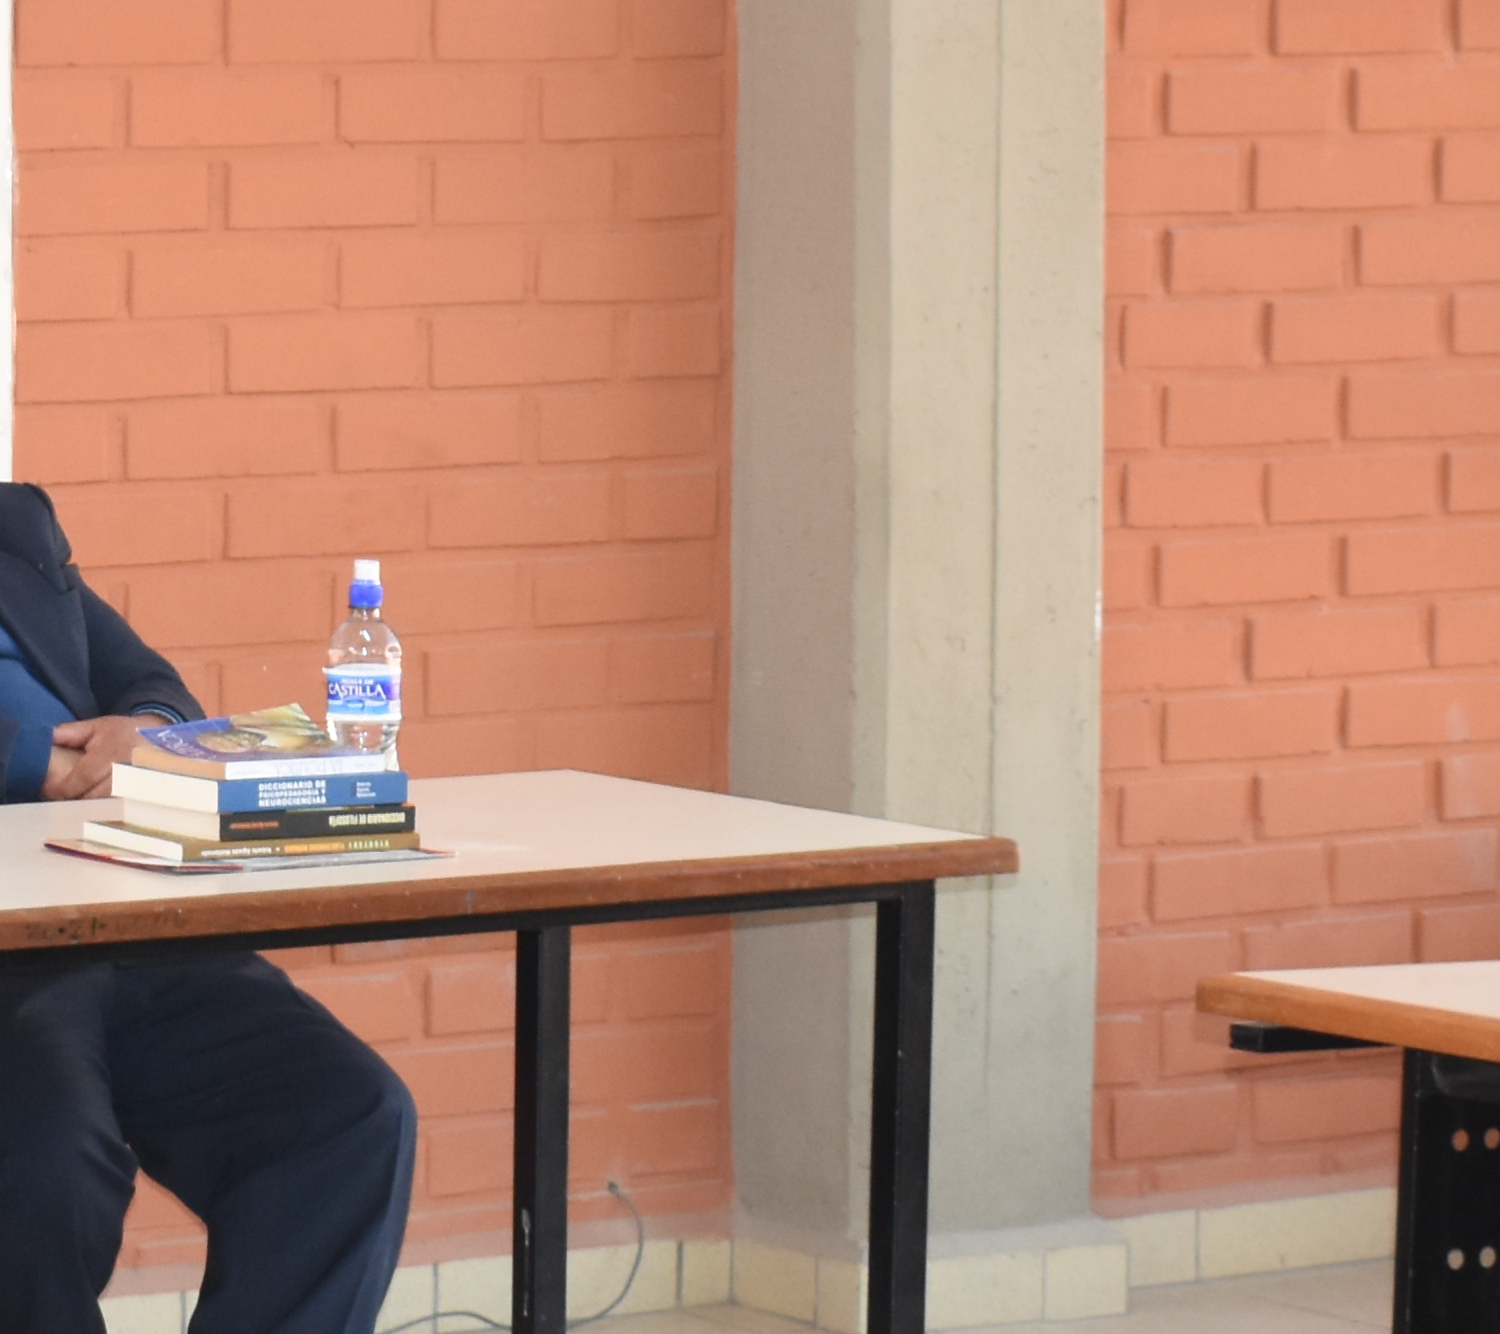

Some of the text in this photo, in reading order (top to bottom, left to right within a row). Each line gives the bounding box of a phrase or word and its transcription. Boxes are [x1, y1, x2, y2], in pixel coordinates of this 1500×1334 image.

[328, 682, 387, 700] CASTILLA
[258, 779, 314, 792] DICCIONARIO
[258, 795, 327, 808] NEUROCIENCIAS
